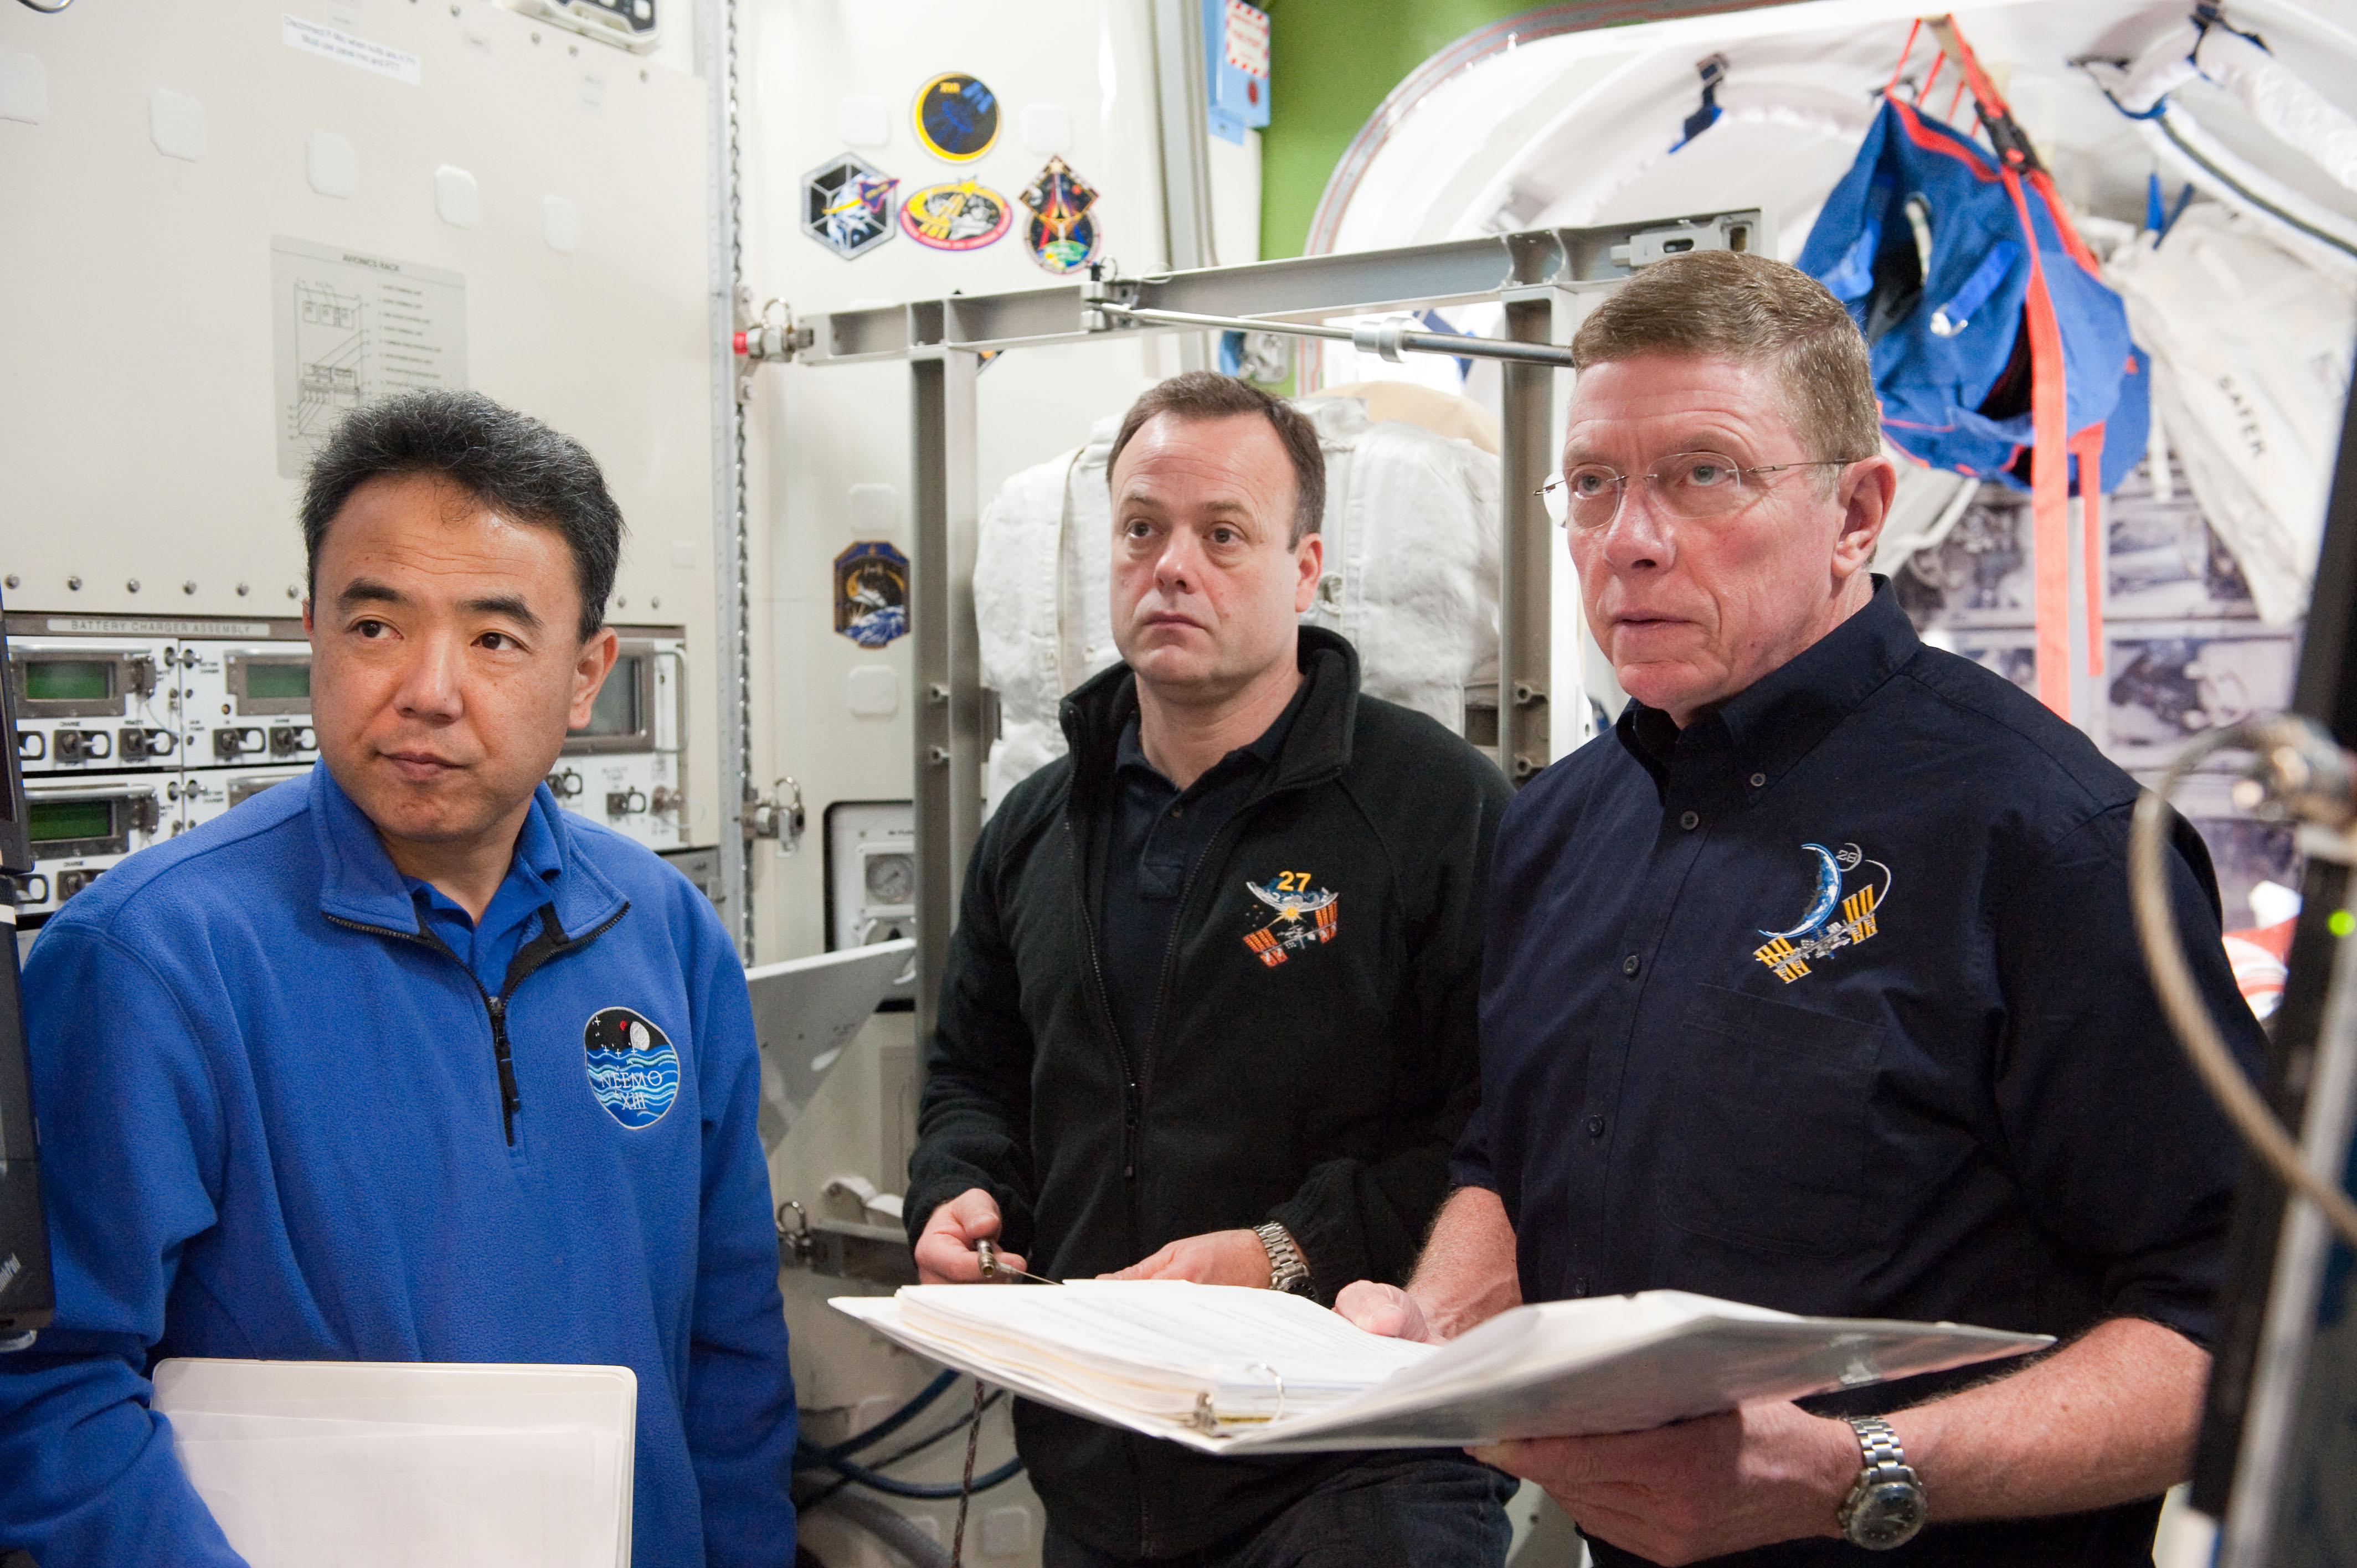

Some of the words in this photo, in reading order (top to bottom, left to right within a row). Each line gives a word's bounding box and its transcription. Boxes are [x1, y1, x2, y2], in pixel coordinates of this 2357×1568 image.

[71, 620, 126, 631] BATTERY
[131, 621, 188, 633] CHARGER
[192, 623, 251, 635] ASSEMBLY
[1835, 849, 1858, 863] 28
[1276, 870, 1312, 893] 27
[600, 1070, 663, 1089] NEEMO
[621, 1092, 648, 1111] XIII
